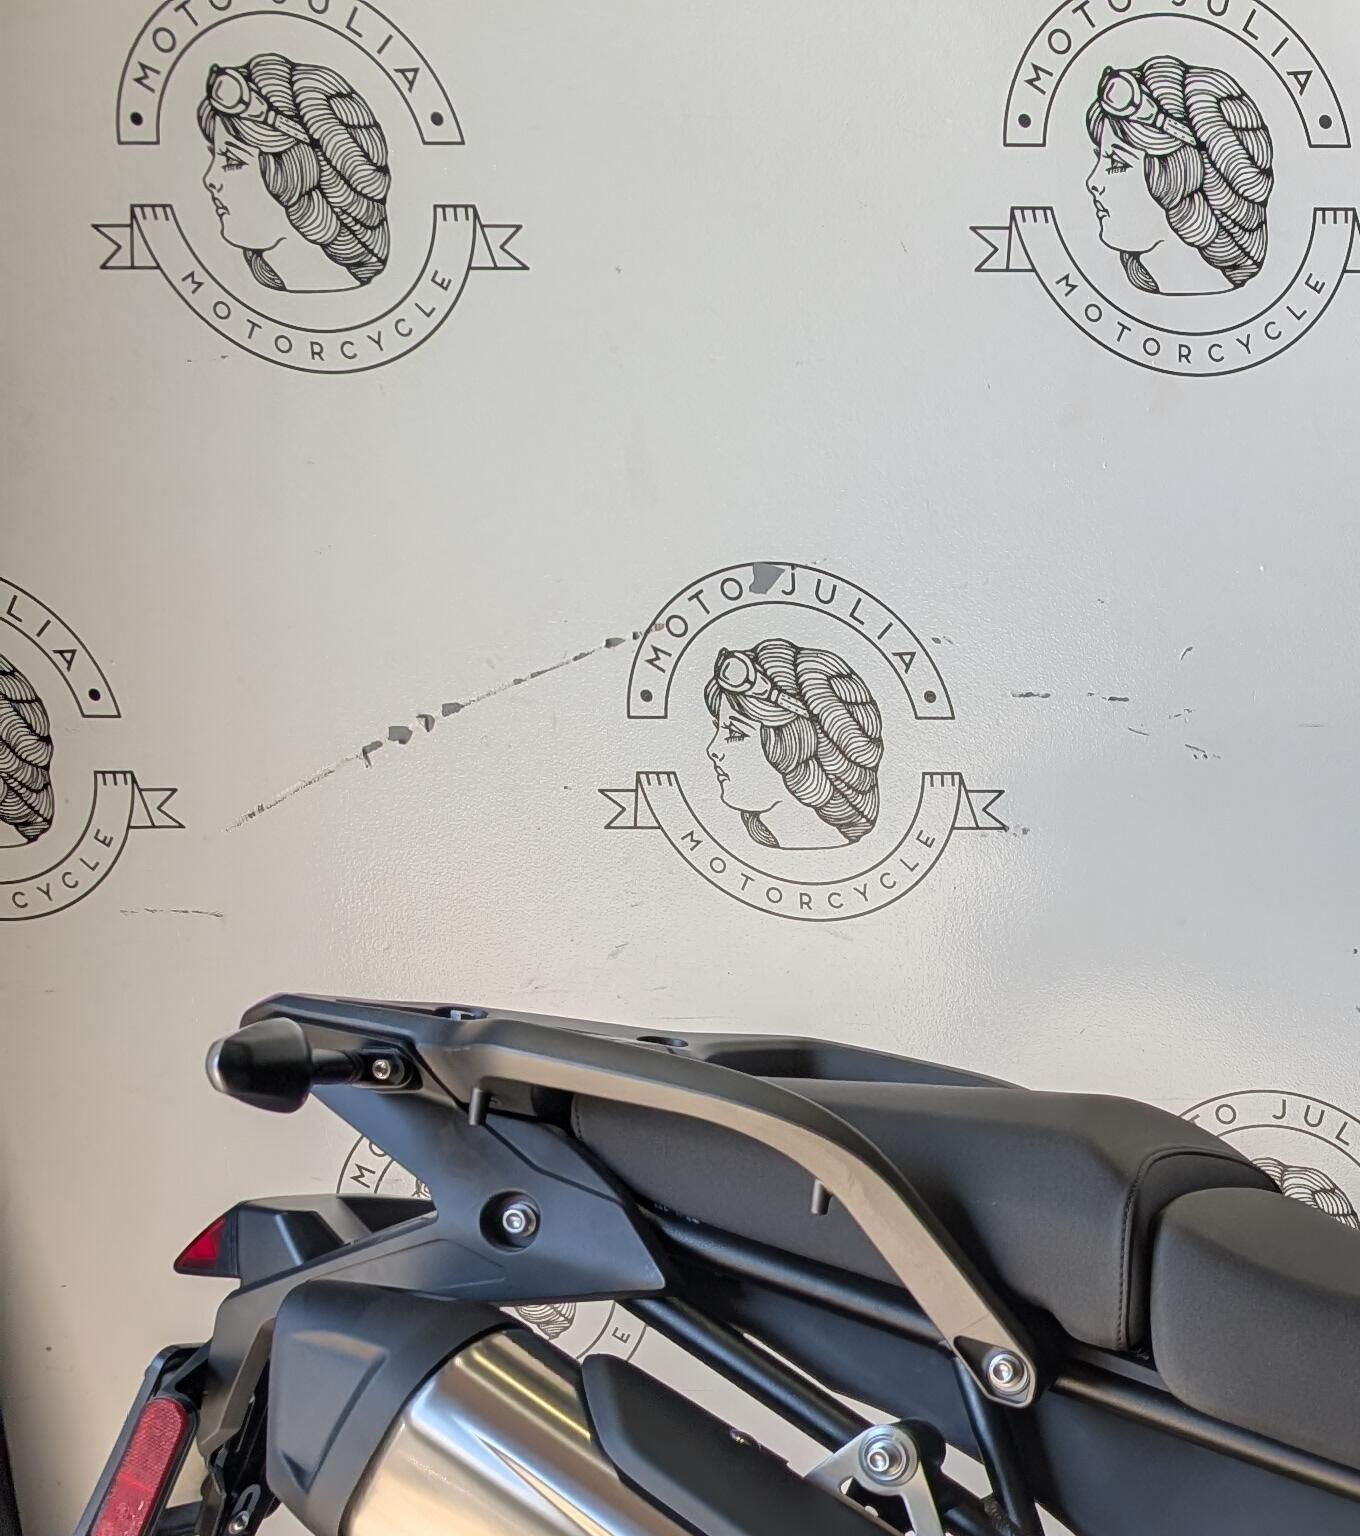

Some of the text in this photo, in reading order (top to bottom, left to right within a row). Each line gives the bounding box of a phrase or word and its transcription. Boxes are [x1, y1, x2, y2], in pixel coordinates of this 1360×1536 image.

[270, 0, 421, 94] ULIA
[1171, 0, 1315, 97] ULIA
[180, 268, 452, 360] MOTORCYCLE
[1055, 272, 1325, 364] MOTORCYCLE
[5, 594, 78, 673] LIA
[643, 567, 918, 674] MOTO JULIA
[11, 828, 114, 909] CYCLE
[680, 828, 936, 908] MOTORCYCLE
